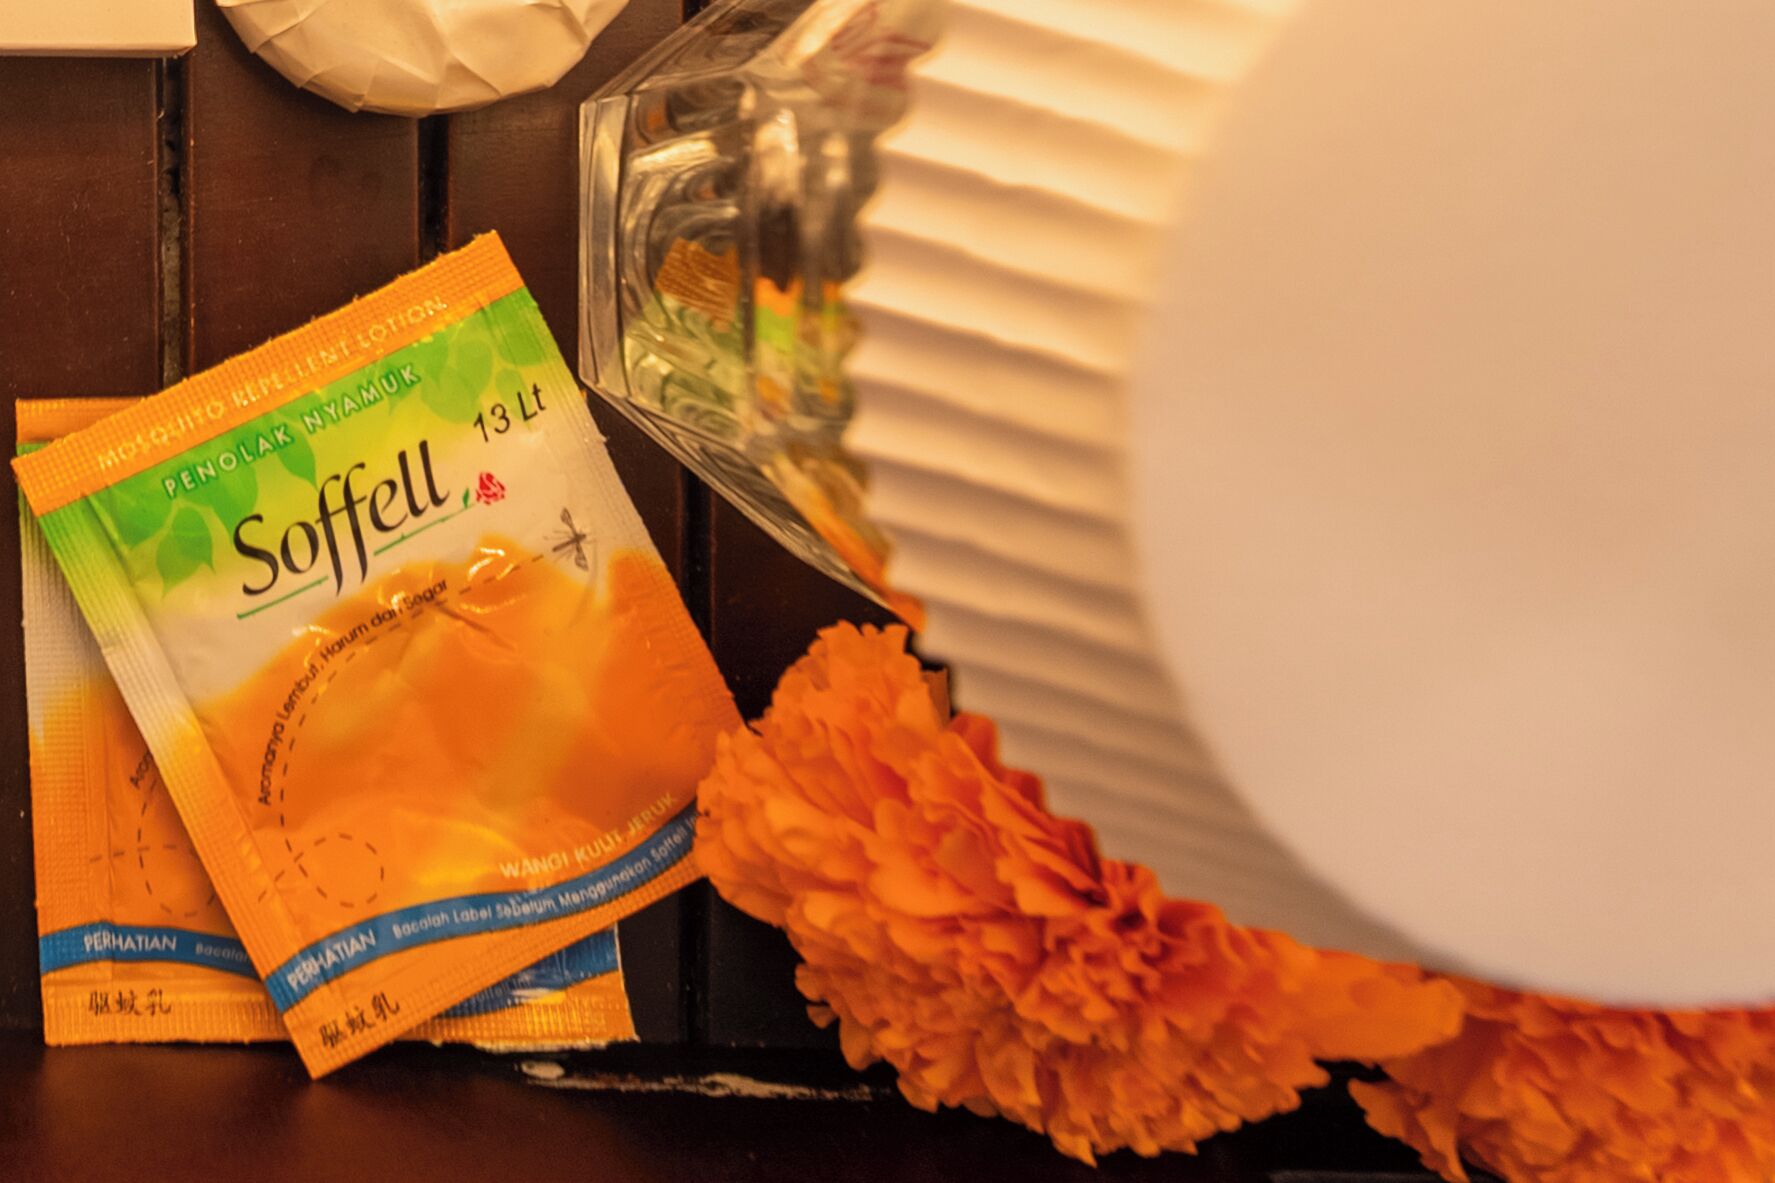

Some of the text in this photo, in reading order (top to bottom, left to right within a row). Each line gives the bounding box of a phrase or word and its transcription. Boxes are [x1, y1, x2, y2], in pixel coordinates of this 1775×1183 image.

[162, 364, 421, 500] PENOLAK NYAMUK
[472, 383, 547, 443] 13 Lt
[232, 439, 450, 598] Soffell
[258, 721, 284, 806] Aromanya
[320, 621, 369, 666] Harum
[498, 852, 569, 880] WANGI
[574, 830, 624, 870] KULIT
[83, 931, 177, 953] PERHATIAN
[286, 929, 377, 993] PERHATIAN
[392, 911, 450, 940] Bacalah
[453, 904, 492, 925] Label
[558, 856, 652, 910] Menggunakan
